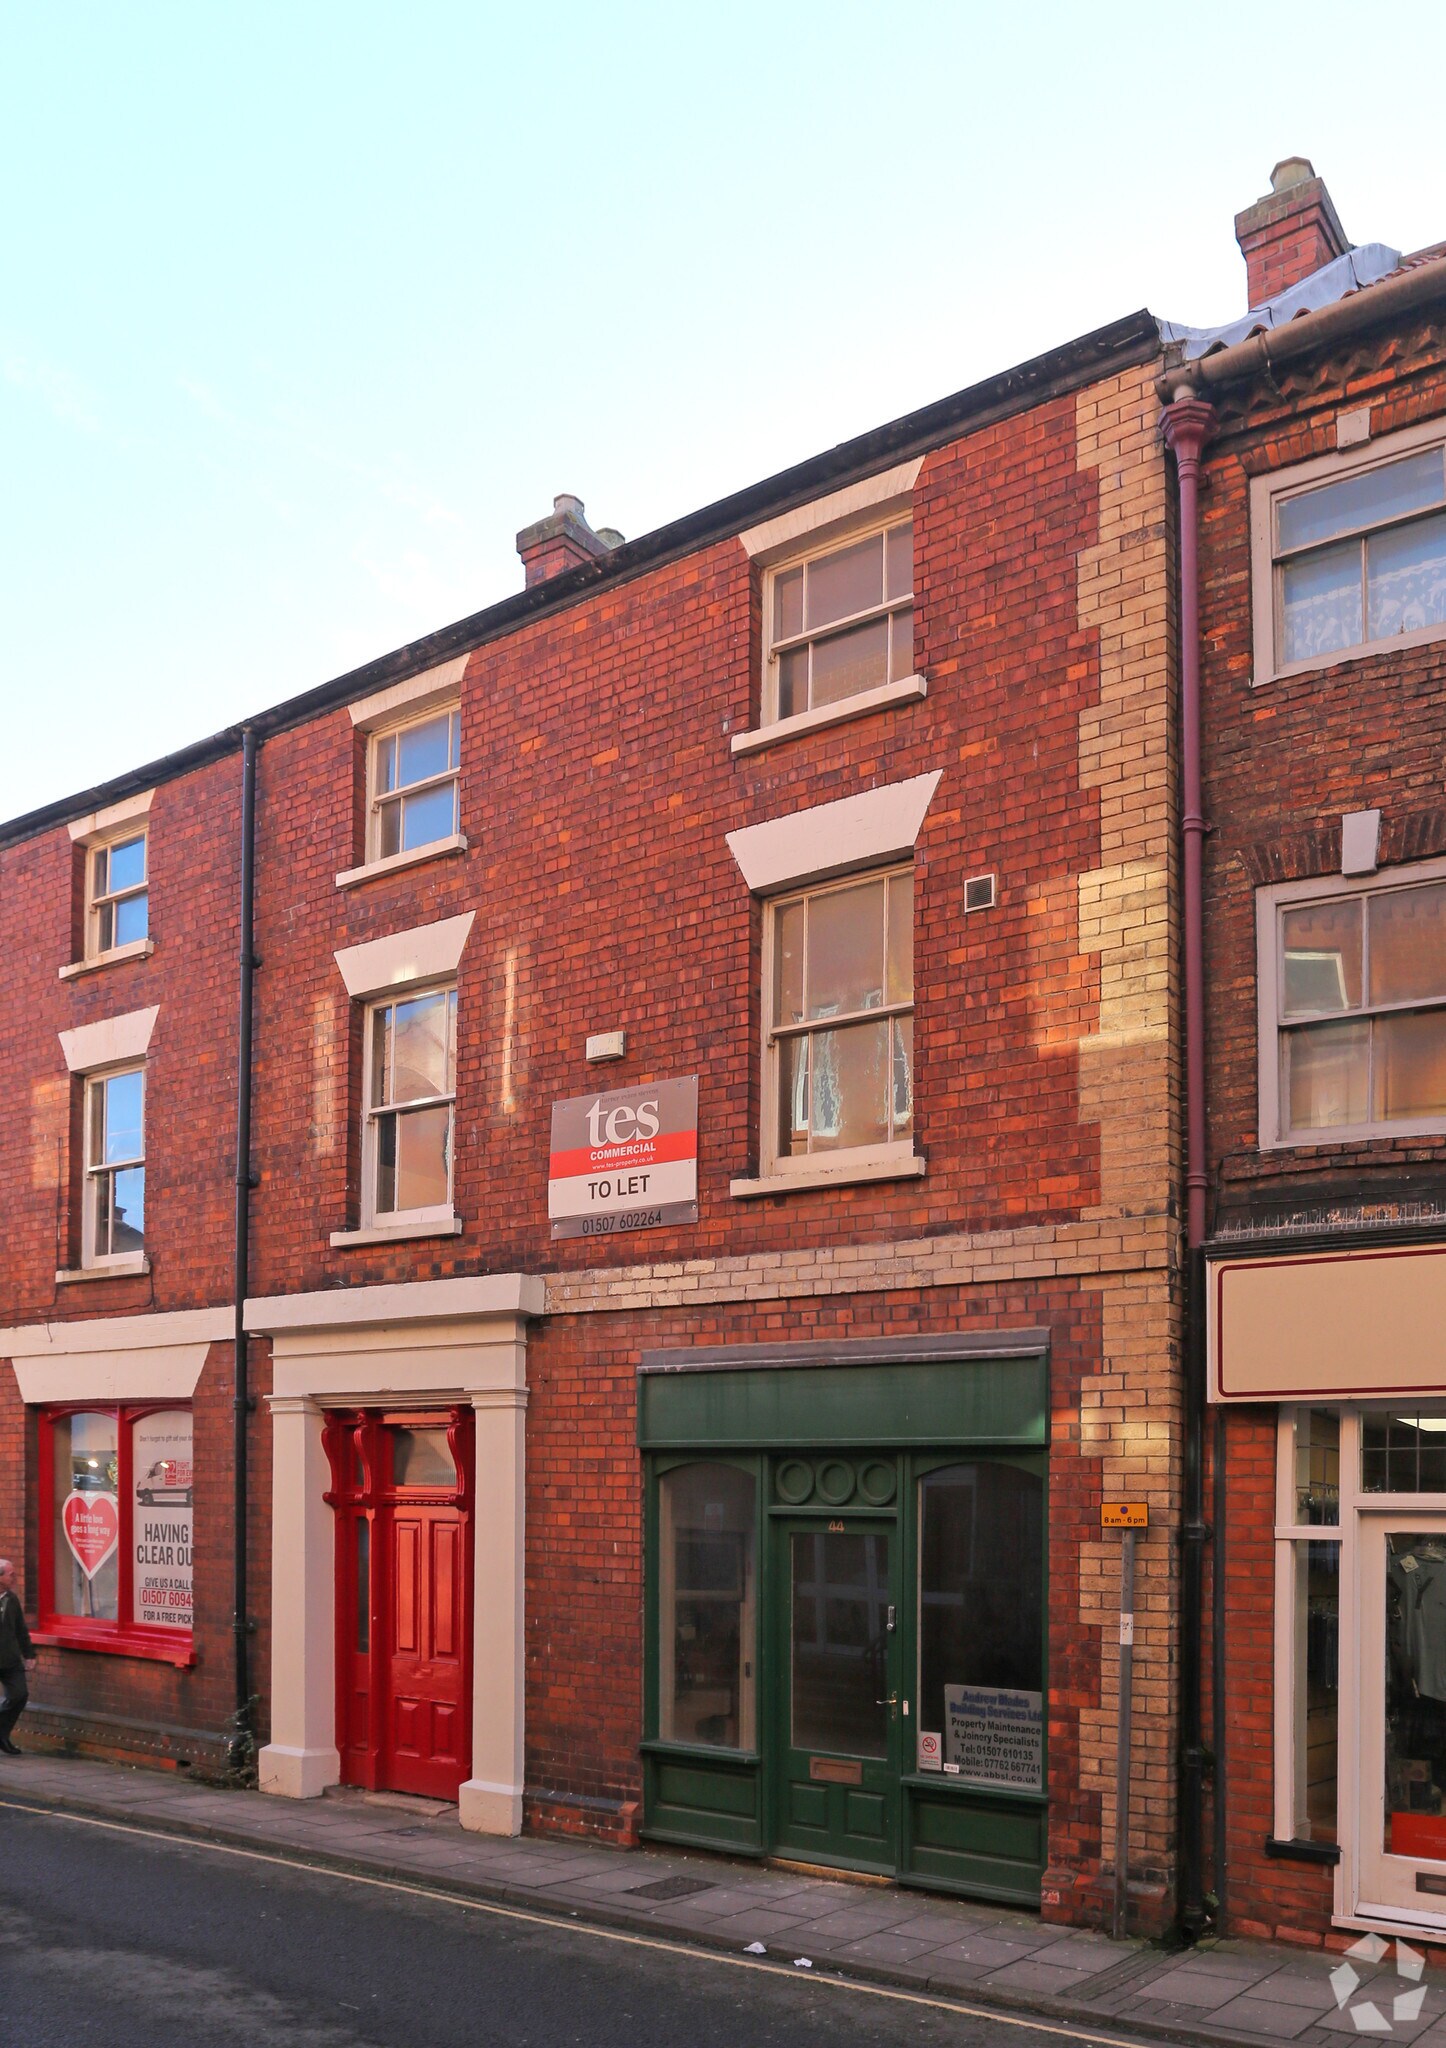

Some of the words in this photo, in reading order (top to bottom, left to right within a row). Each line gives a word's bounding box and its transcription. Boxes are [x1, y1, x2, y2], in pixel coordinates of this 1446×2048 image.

[585, 1099, 660, 1148] tes
[590, 1142, 656, 1161] COMMERCIAL
[592, 1155, 654, 1170] www.tes-property.co.uk
[588, 1180, 611, 1199] TO
[617, 1174, 651, 1196] LET
[582, 1216, 615, 1234] 01507
[619, 1211, 662, 1229] 602264
[75, 1513, 79, 1522] A
[828, 1520, 845, 1532] 44
[1133, 1517, 1145, 1525] pm
[70, 1525, 83, 1535] goes
[87, 1525, 99, 1536] long
[99, 1527, 111, 1537] way
[144, 1523, 189, 1544] HAVING
[137, 1545, 174, 1566] CLEAR
[177, 1547, 193, 1567] OU
[144, 1577, 159, 1588] GIVE
[159, 1578, 168, 1588] US
[169, 1578, 174, 1589] A
[174, 1579, 190, 1590] CALL
[142, 1589, 167, 1605] 01507
[169, 1591, 193, 1608] 6094
[143, 1610, 156, 1621] FOR
[156, 1611, 160, 1621] A
[161, 1611, 176, 1623] FREE
[962, 1690, 997, 1705] Andrew
[949, 1702, 986, 1718] Building
[986, 1705, 1027, 1721] Services
[951, 1717, 986, 1731] Property
[987, 1720, 1041, 1736] Maintenance
[954, 1730, 960, 1738] &
[961, 1730, 992, 1744] Joinery
[993, 1734, 1039, 1748] Specialists
[960, 1743, 976, 1754] Tel:
[976, 1745, 1001, 1756] 01507
[1002, 1748, 1034, 1761] 610135
[954, 1754, 984, 1768] Mobile:
[984, 1758, 1009, 1771] 07762
[1010, 1761, 1041, 1774] 667741
[958, 1768, 1038, 1784] www.abbsl.co.uk
